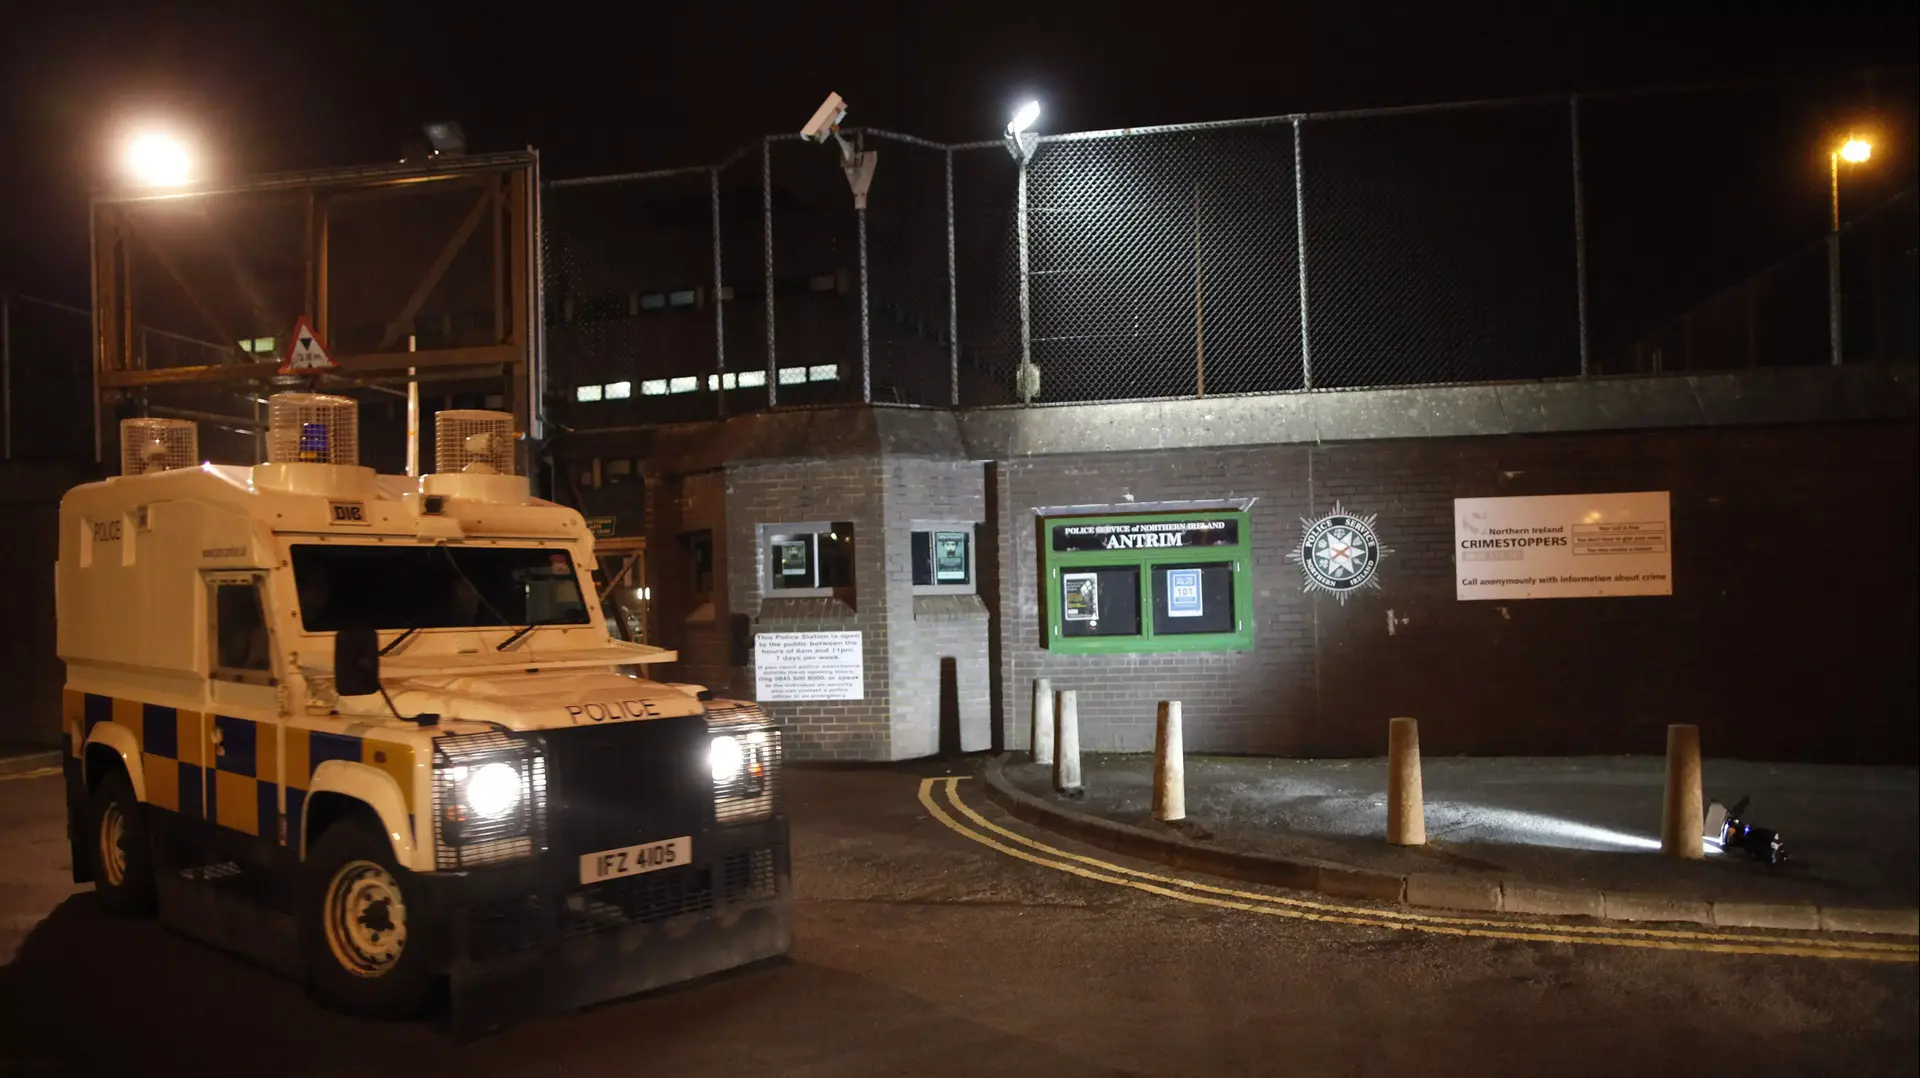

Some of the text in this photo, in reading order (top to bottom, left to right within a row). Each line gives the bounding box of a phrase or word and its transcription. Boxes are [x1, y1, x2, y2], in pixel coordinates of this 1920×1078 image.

[94, 520, 121, 541] POLICE
[1065, 527, 1095, 535] POLICE
[1095, 525, 1130, 534] SERVICE
[1140, 523, 1186, 532] NORTHERN
[1187, 521, 1225, 530] IRELAND
[1305, 518, 1376, 548] POLICE SERVICE
[1489, 526, 1564, 536] Northern Ireland
[1106, 532, 1184, 549] ANTRIM
[1461, 536, 1568, 549] CRIMESTOPPERS
[1306, 558, 1374, 587] NORTHERN IRELAND
[1462, 573, 1666, 586] Call anonymously with information about crime
[1177, 587, 1193, 596] 101
[564, 698, 661, 725] POLICE
[596, 843, 676, 877] IFZ 4105
